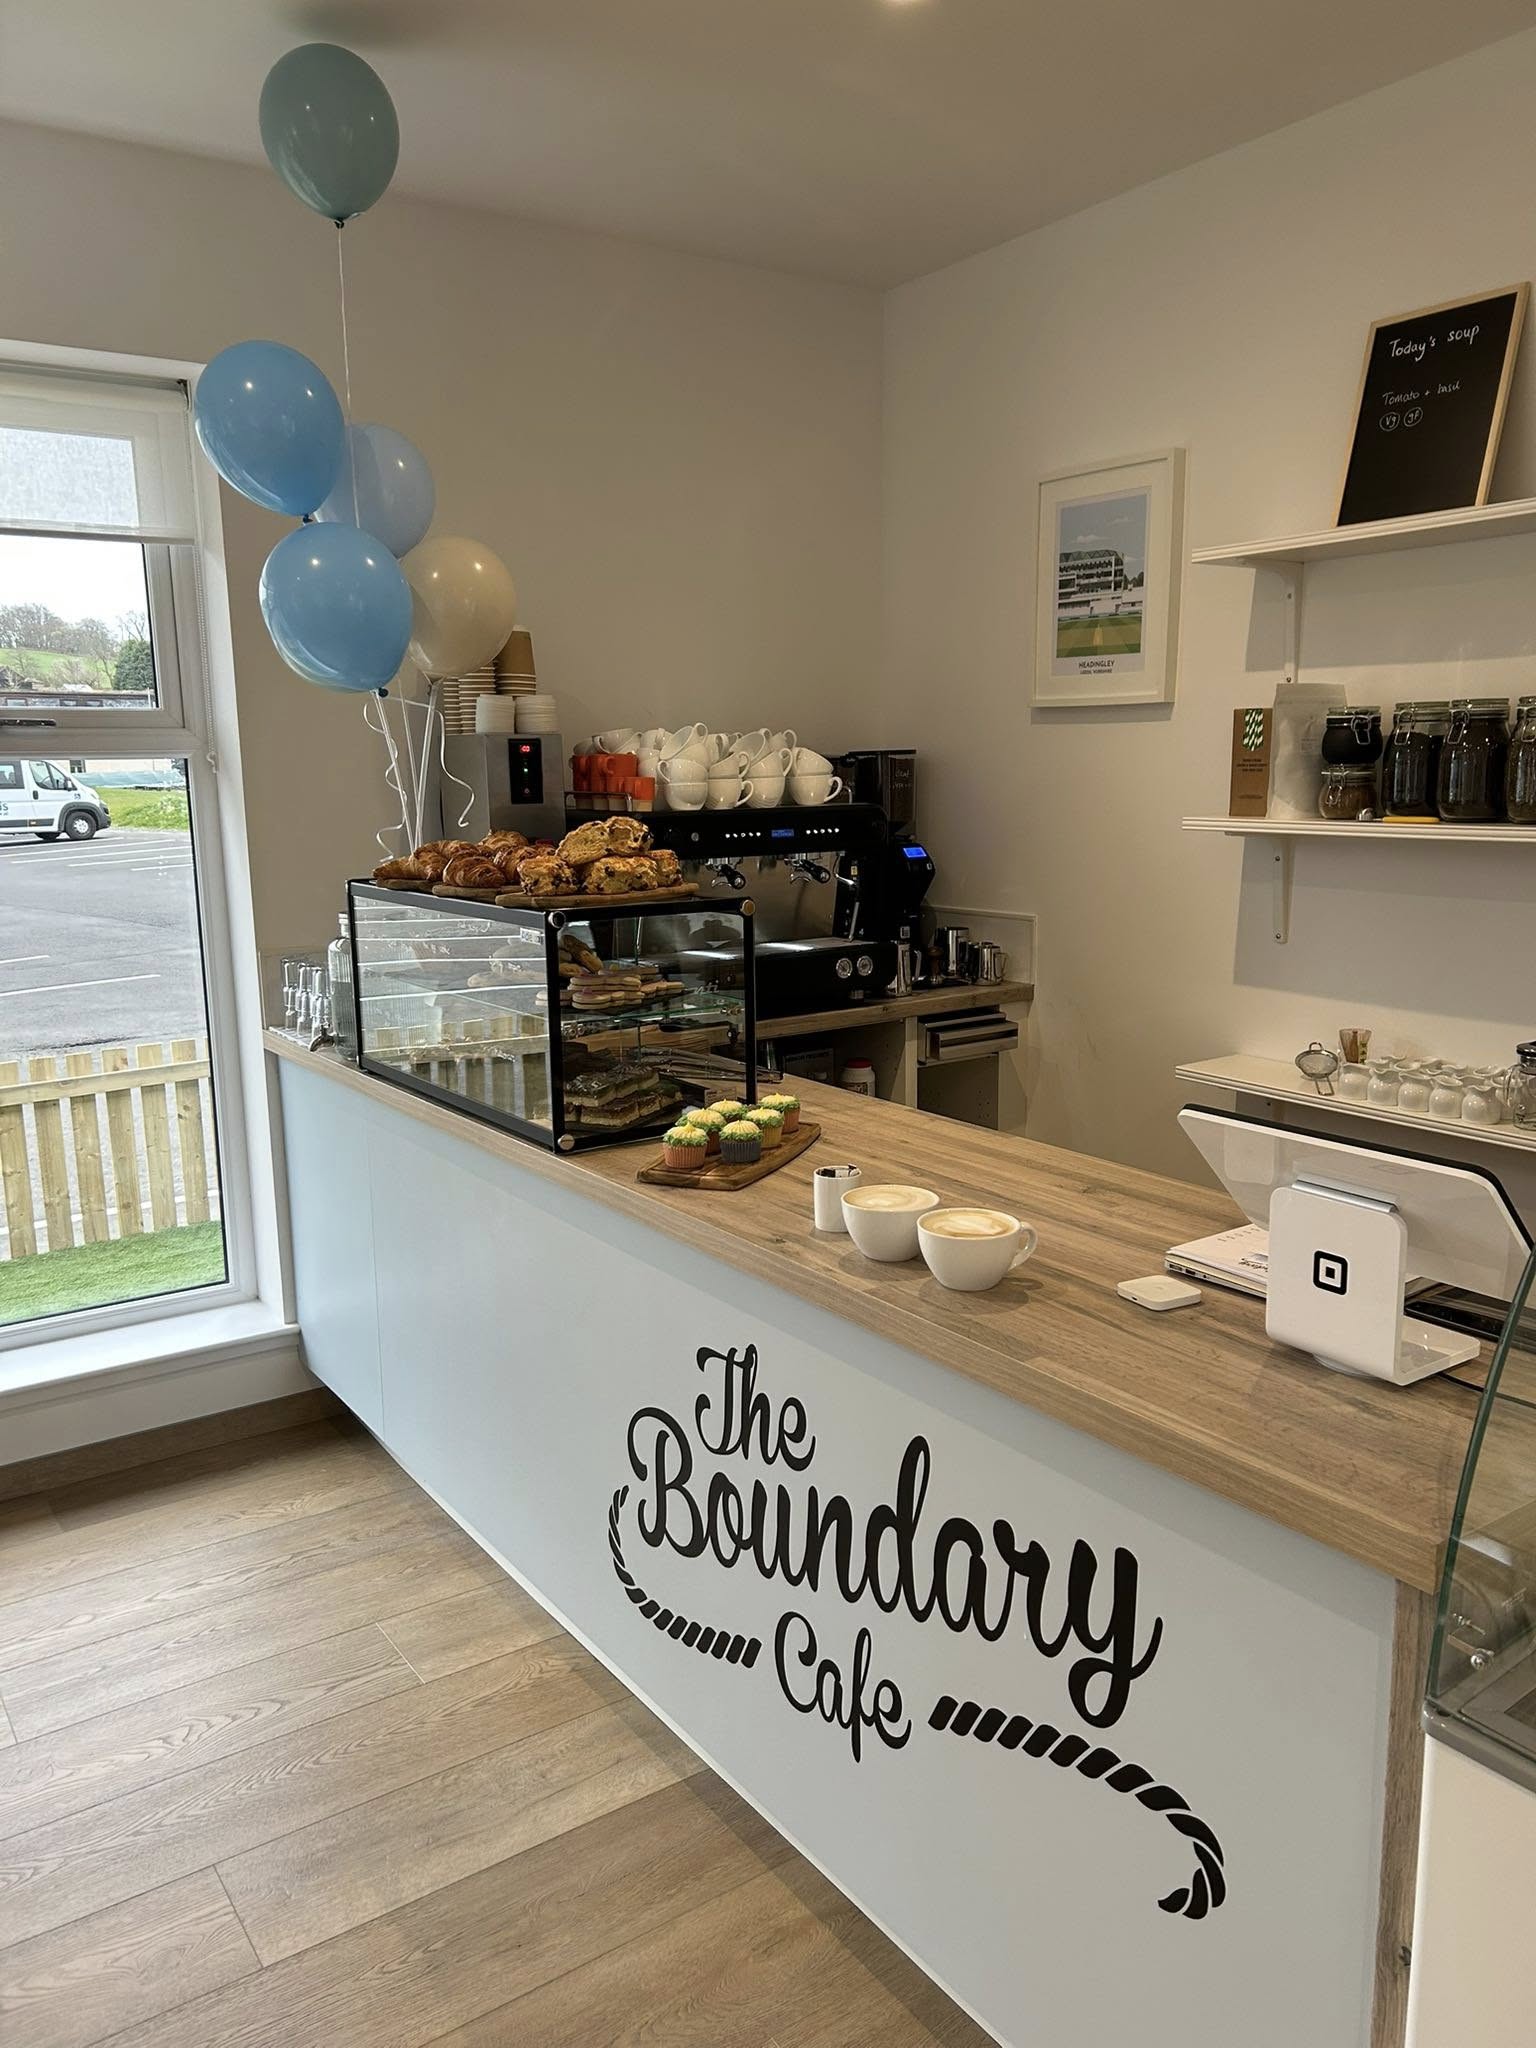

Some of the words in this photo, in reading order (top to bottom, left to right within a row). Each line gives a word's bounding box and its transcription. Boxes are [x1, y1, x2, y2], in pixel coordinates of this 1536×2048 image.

[1389, 335, 1437, 362] Today's
[1447, 325, 1480, 345] soup
[1382, 391, 1420, 406] Tomato
[1078, 660, 1115, 669] HEADINGLEY
[695, 1343, 815, 1472] The
[627, 1407, 1163, 1728] Boundary
[774, 1611, 912, 1763] Cafe
